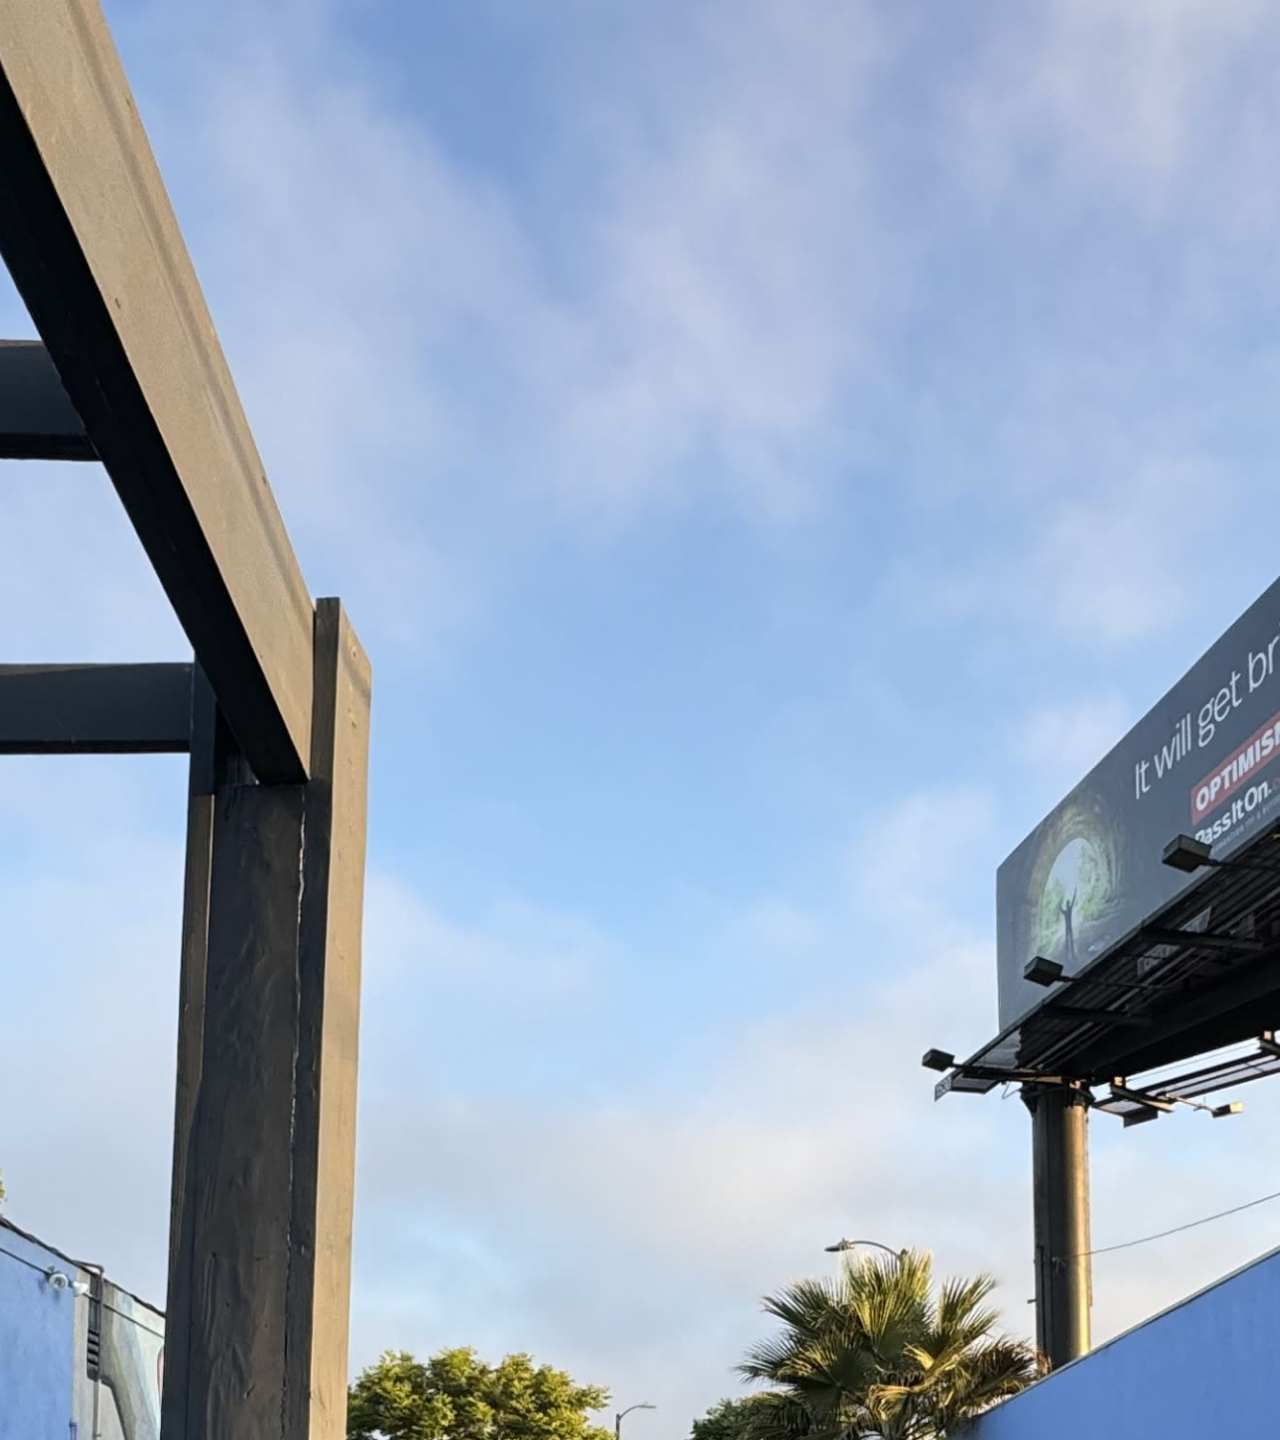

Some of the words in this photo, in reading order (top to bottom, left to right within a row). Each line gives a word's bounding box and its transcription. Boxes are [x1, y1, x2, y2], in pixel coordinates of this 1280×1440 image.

[1134, 760, 1151, 800] It
[1153, 712, 1192, 779] will
[1197, 671, 1242, 748] get
